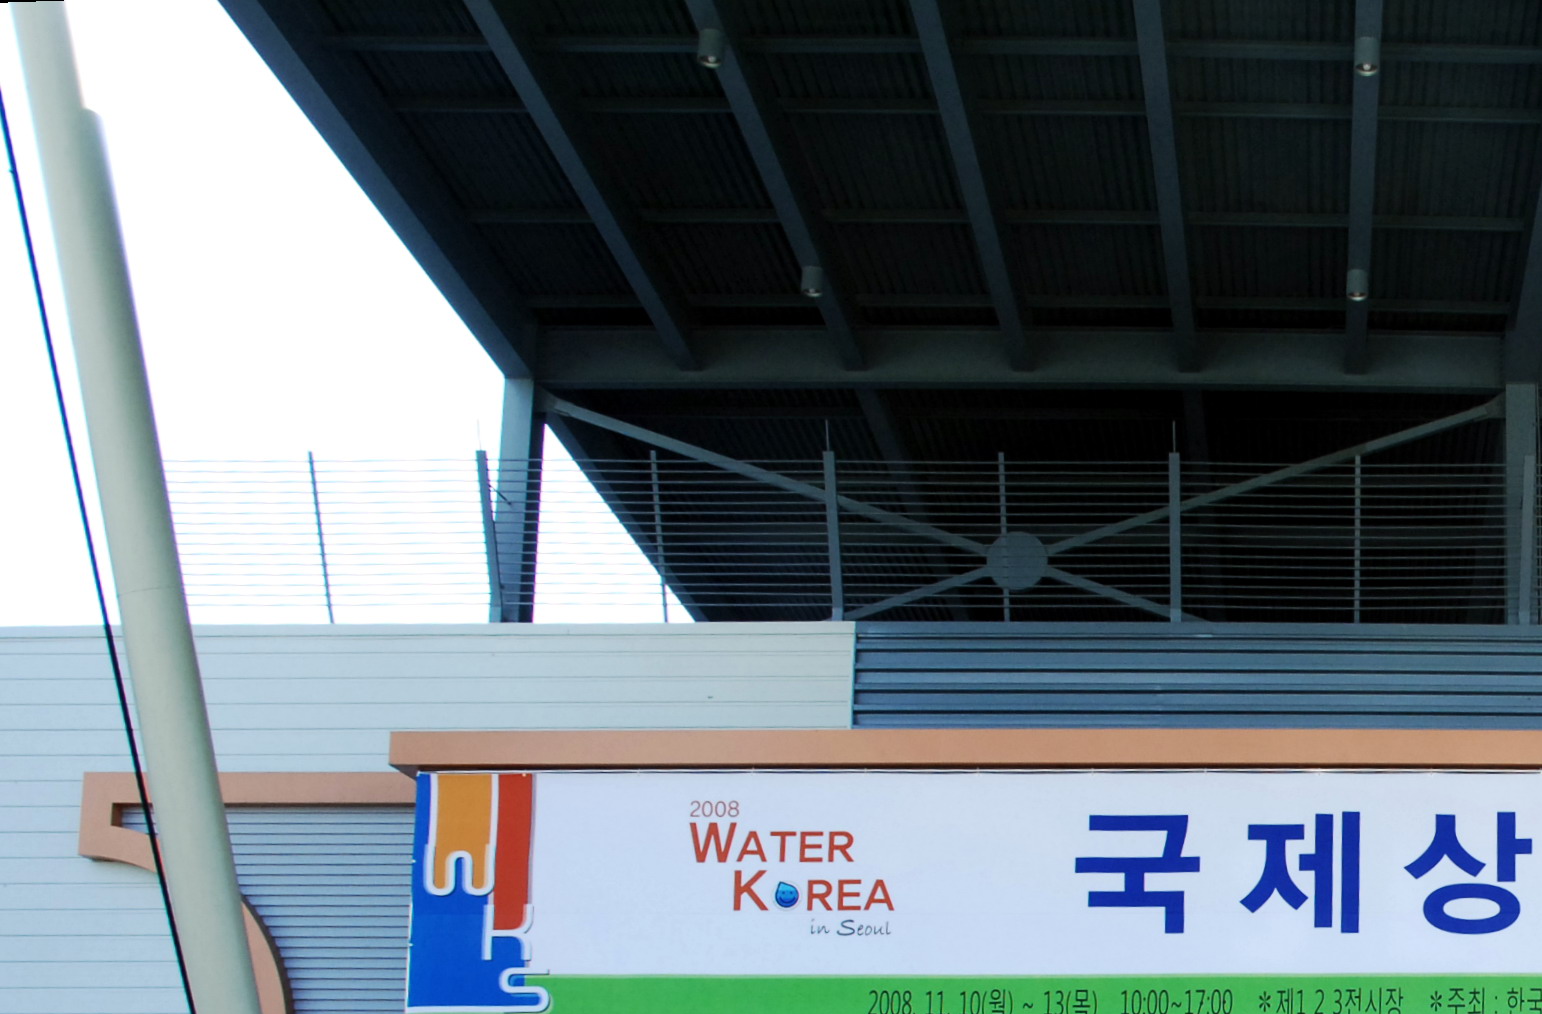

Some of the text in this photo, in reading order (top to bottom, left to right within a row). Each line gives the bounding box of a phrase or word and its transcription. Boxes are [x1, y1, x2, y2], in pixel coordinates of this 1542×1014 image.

[690, 799, 740, 818] 2008
[689, 821, 855, 864] WATER
[732, 869, 895, 912] KOREA
[810, 918, 891, 937] in Seoul
